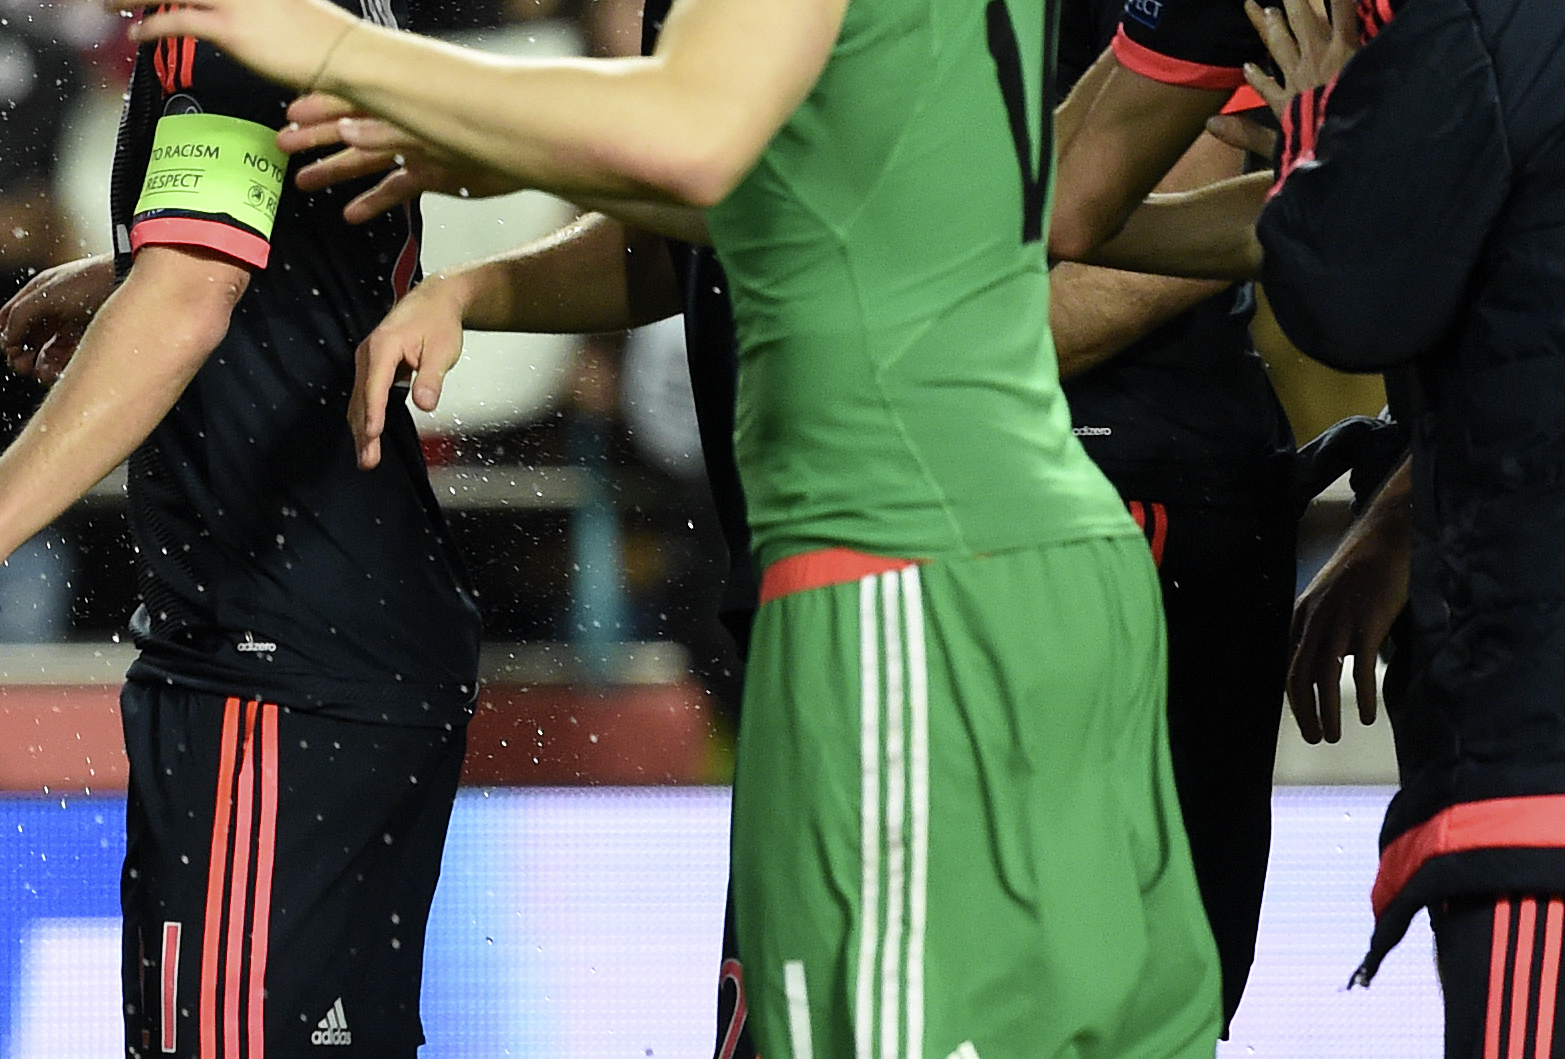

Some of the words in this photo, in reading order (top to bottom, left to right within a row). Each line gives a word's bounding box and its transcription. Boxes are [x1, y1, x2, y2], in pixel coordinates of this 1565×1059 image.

[164, 143, 220, 160] RACISM
[243, 152, 269, 172] NO
[146, 173, 204, 190] RESPECT
[310, 1029, 352, 1046] adidas
